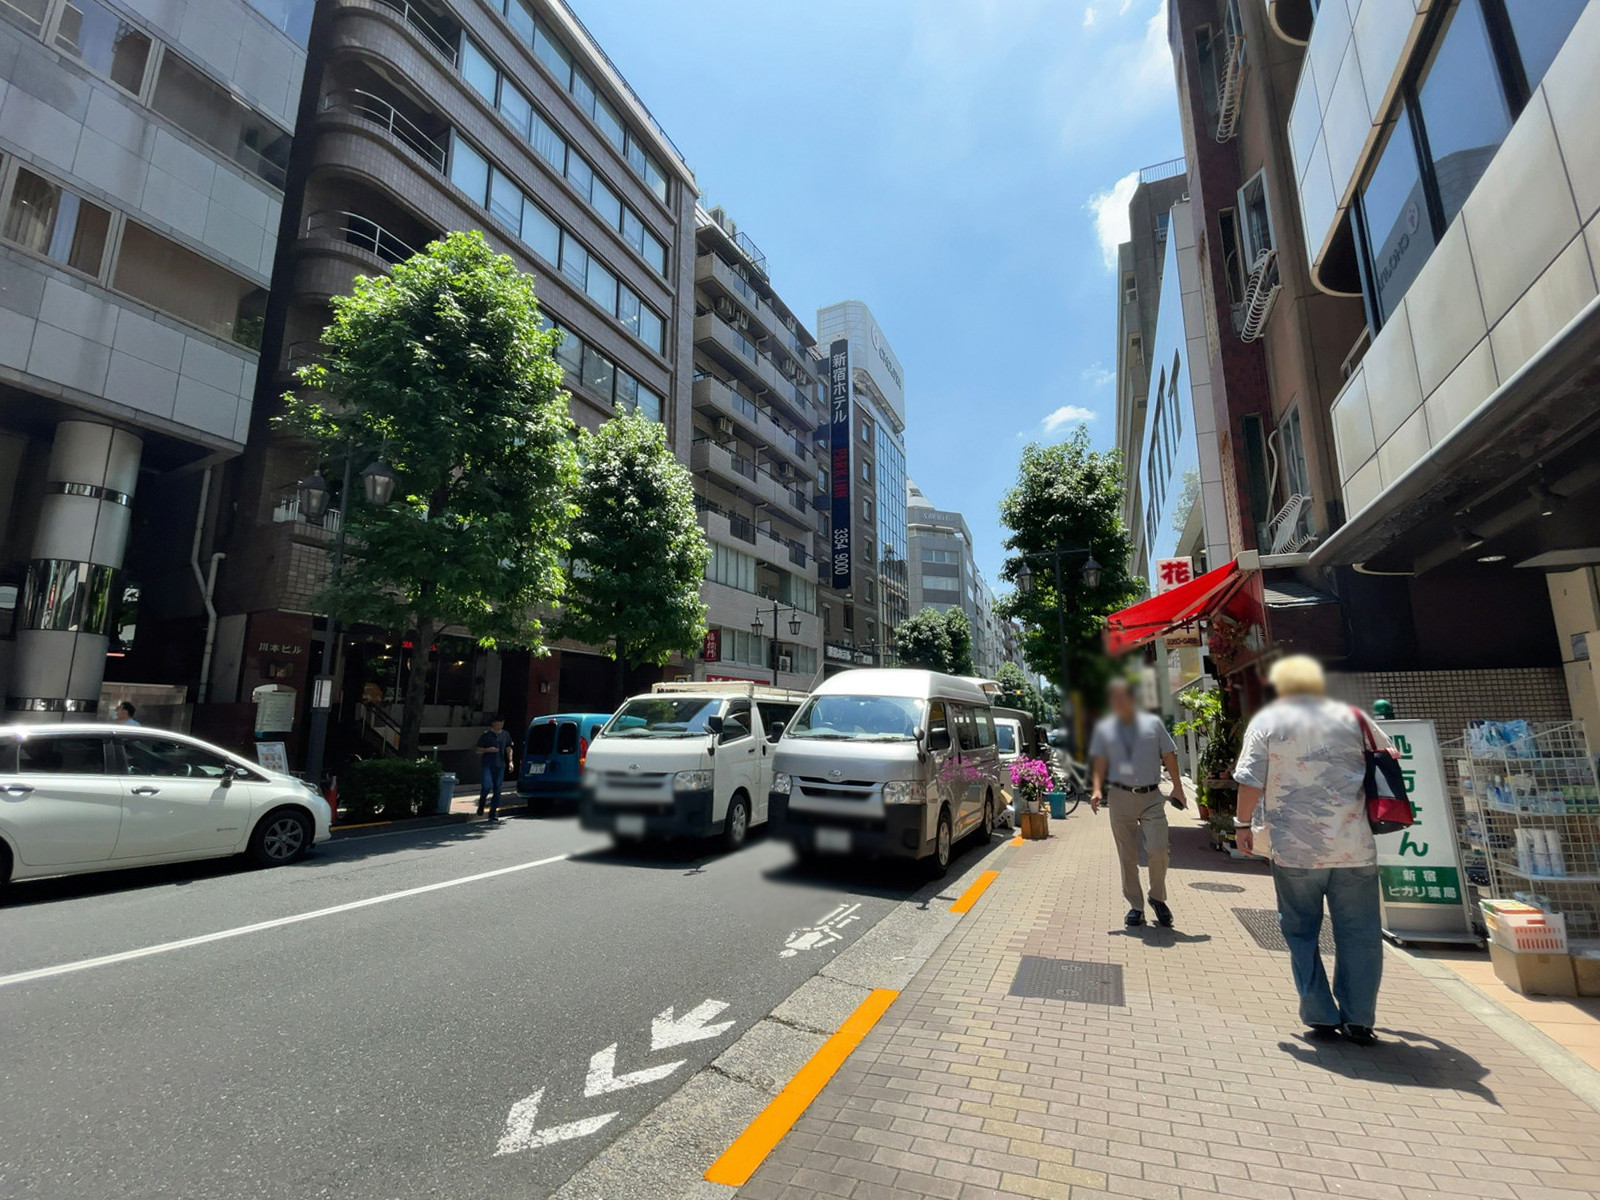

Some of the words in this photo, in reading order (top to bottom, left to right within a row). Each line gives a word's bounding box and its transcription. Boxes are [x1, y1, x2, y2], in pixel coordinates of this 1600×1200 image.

[832, 352, 847, 424] 新宿ホテル
[834, 527, 849, 550] 3354
[834, 553, 849, 575] 9000
[1160, 561, 1190, 585] 花
[258, 642, 303, 655] 川本ビル
[1402, 869, 1437, 883] 新宿
[1388, 885, 1457, 900] ヒカリ薬局
